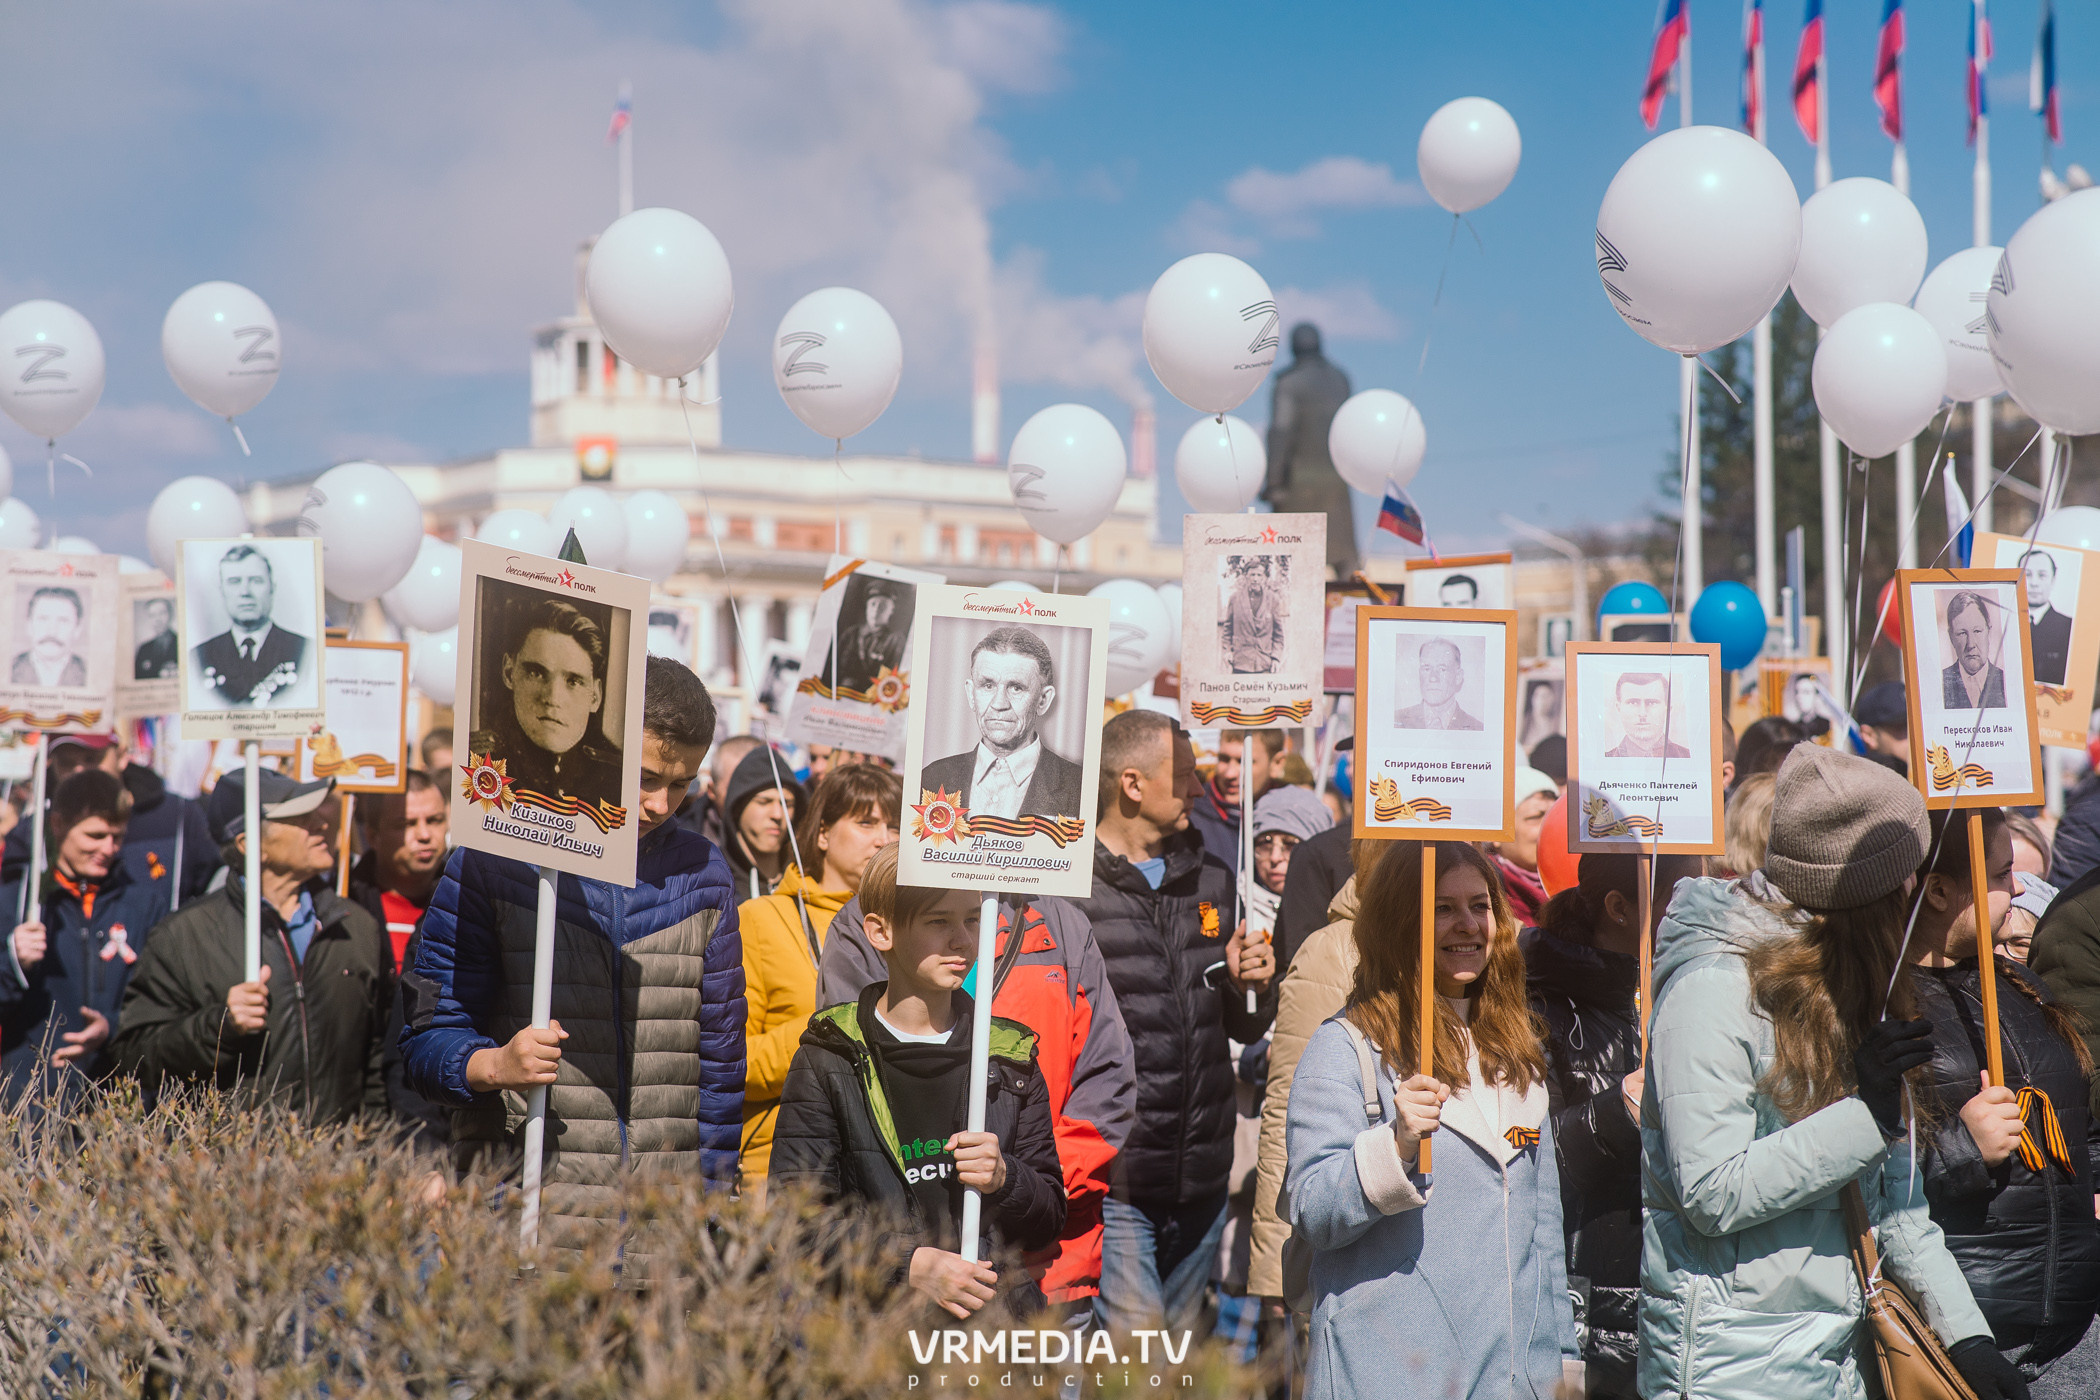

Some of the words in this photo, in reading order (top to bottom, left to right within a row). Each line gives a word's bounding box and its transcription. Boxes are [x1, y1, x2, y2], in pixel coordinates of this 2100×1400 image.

[1200, 682, 1230, 692] Панов
[1233, 681, 1264, 692] Семён
[1267, 681, 1307, 693] Кузьмич
[1232, 696, 1270, 704] Старшина
[1993, 725, 2013, 733] Иван
[1954, 740, 2004, 748] Николаевич
[1384, 760, 1447, 770] Спиридонов
[1450, 761, 1492, 770] Евгений
[1411, 774, 1464, 784] Ефимович
[1599, 781, 1647, 790] Дьяченко
[1650, 781, 1698, 789] Пантелей
[1619, 794, 1679, 802] Леонтьевич
[511, 801, 575, 831] Кизиков
[483, 814, 550, 844] Николай
[553, 832, 603, 857] Ильич
[971, 834, 1023, 851] Дьяков
[922, 847, 983, 863] Василий
[985, 852, 1071, 870] Кириллович
[951, 872, 995, 881] старший
[997, 874, 1039, 884] сержант
